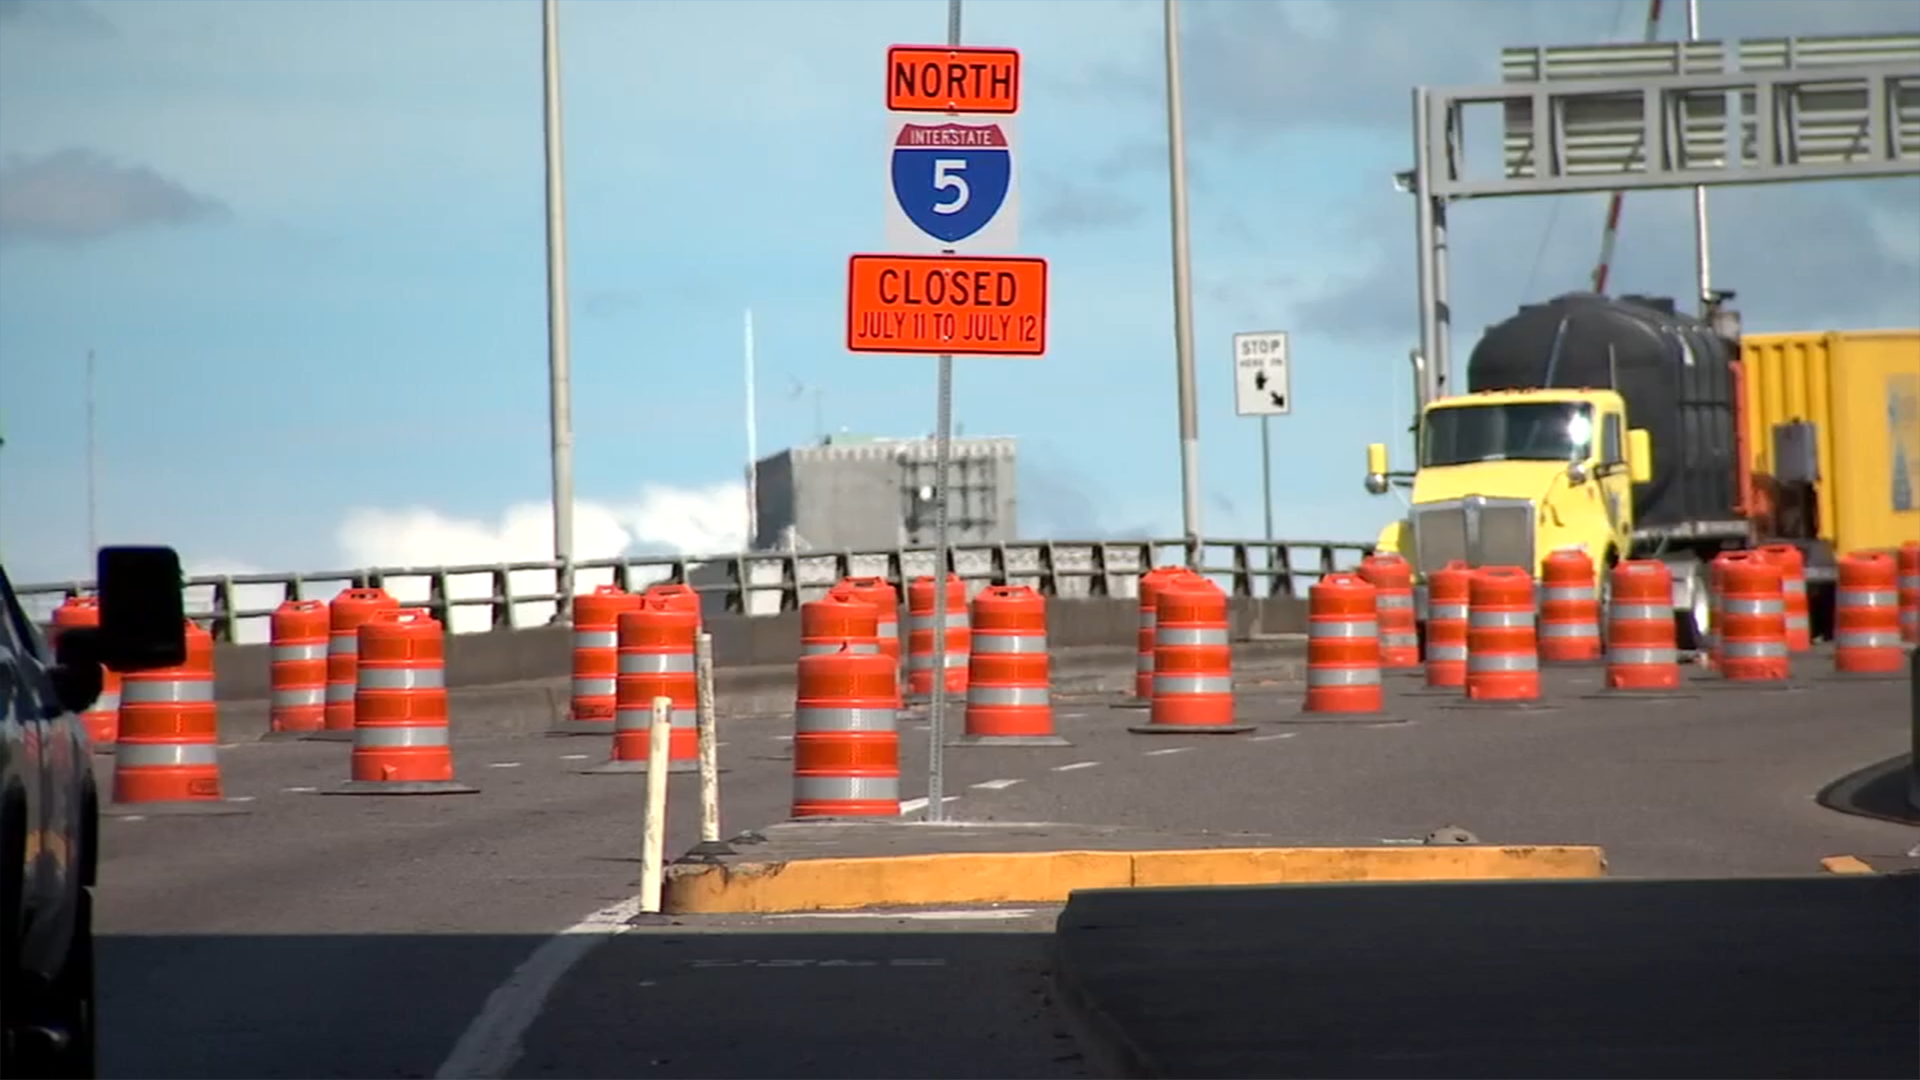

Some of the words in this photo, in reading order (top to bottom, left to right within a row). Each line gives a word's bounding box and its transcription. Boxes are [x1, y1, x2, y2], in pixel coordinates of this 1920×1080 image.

[895, 61, 1011, 99] NORTH
[910, 130, 992, 145] INTERSTATE
[932, 159, 970, 215] 5
[879, 269, 1016, 306] CLOSED
[858, 311, 906, 338] JULY
[914, 313, 925, 339] 11
[933, 313, 955, 340] TO
[963, 314, 1011, 341] JULY
[1019, 315, 1036, 341] 12
[1242, 339, 1281, 355] STOP
